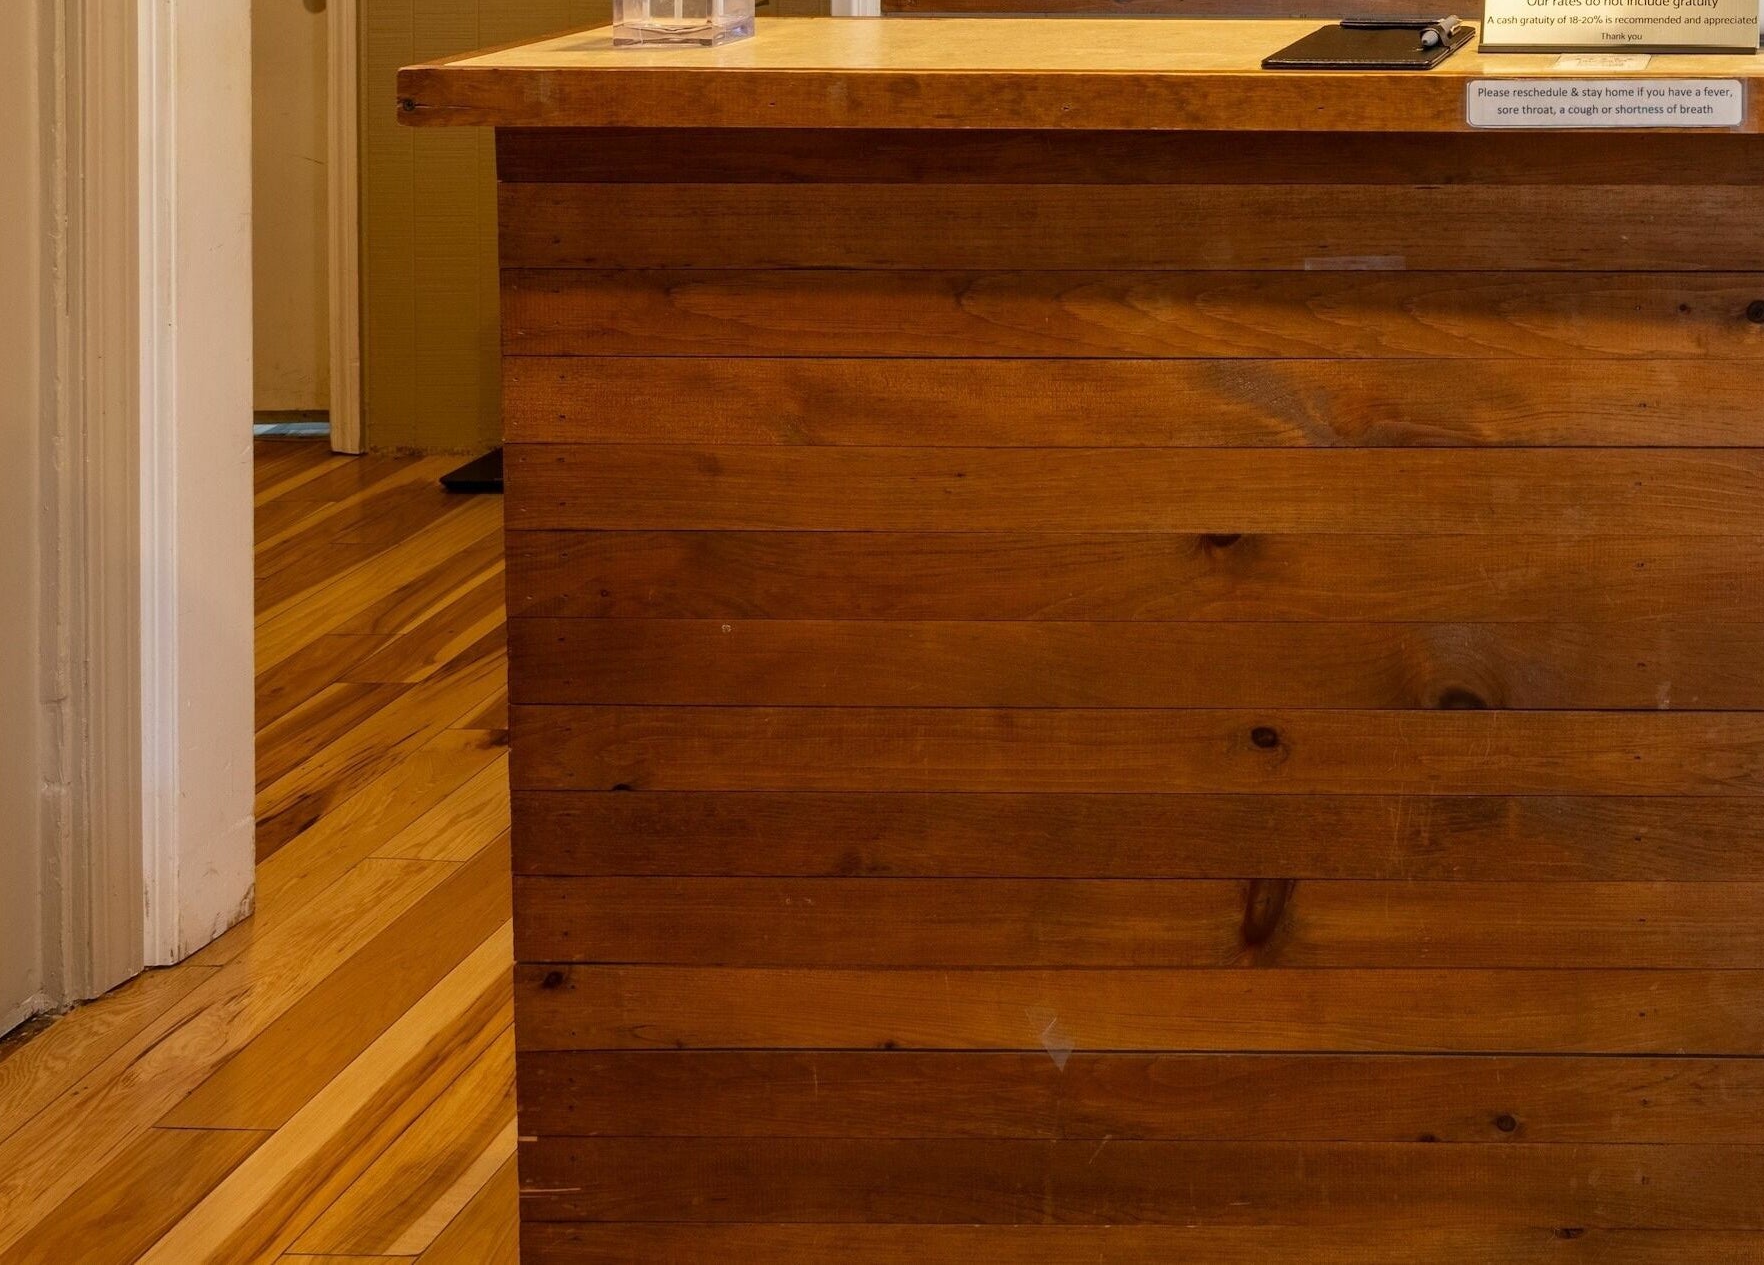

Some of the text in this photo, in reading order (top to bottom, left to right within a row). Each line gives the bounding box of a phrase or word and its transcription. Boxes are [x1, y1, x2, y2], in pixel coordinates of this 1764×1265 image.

[1487, 15, 1758, 26] A cash gratuity of 18-20% is recommended and appreciated
[1600, 32, 1643, 42] Thank you
[1478, 87, 1733, 99] Please reschedule & stay home if you have a fever,
[1497, 105, 1713, 116] sore throat, a cough or shortness of breath
